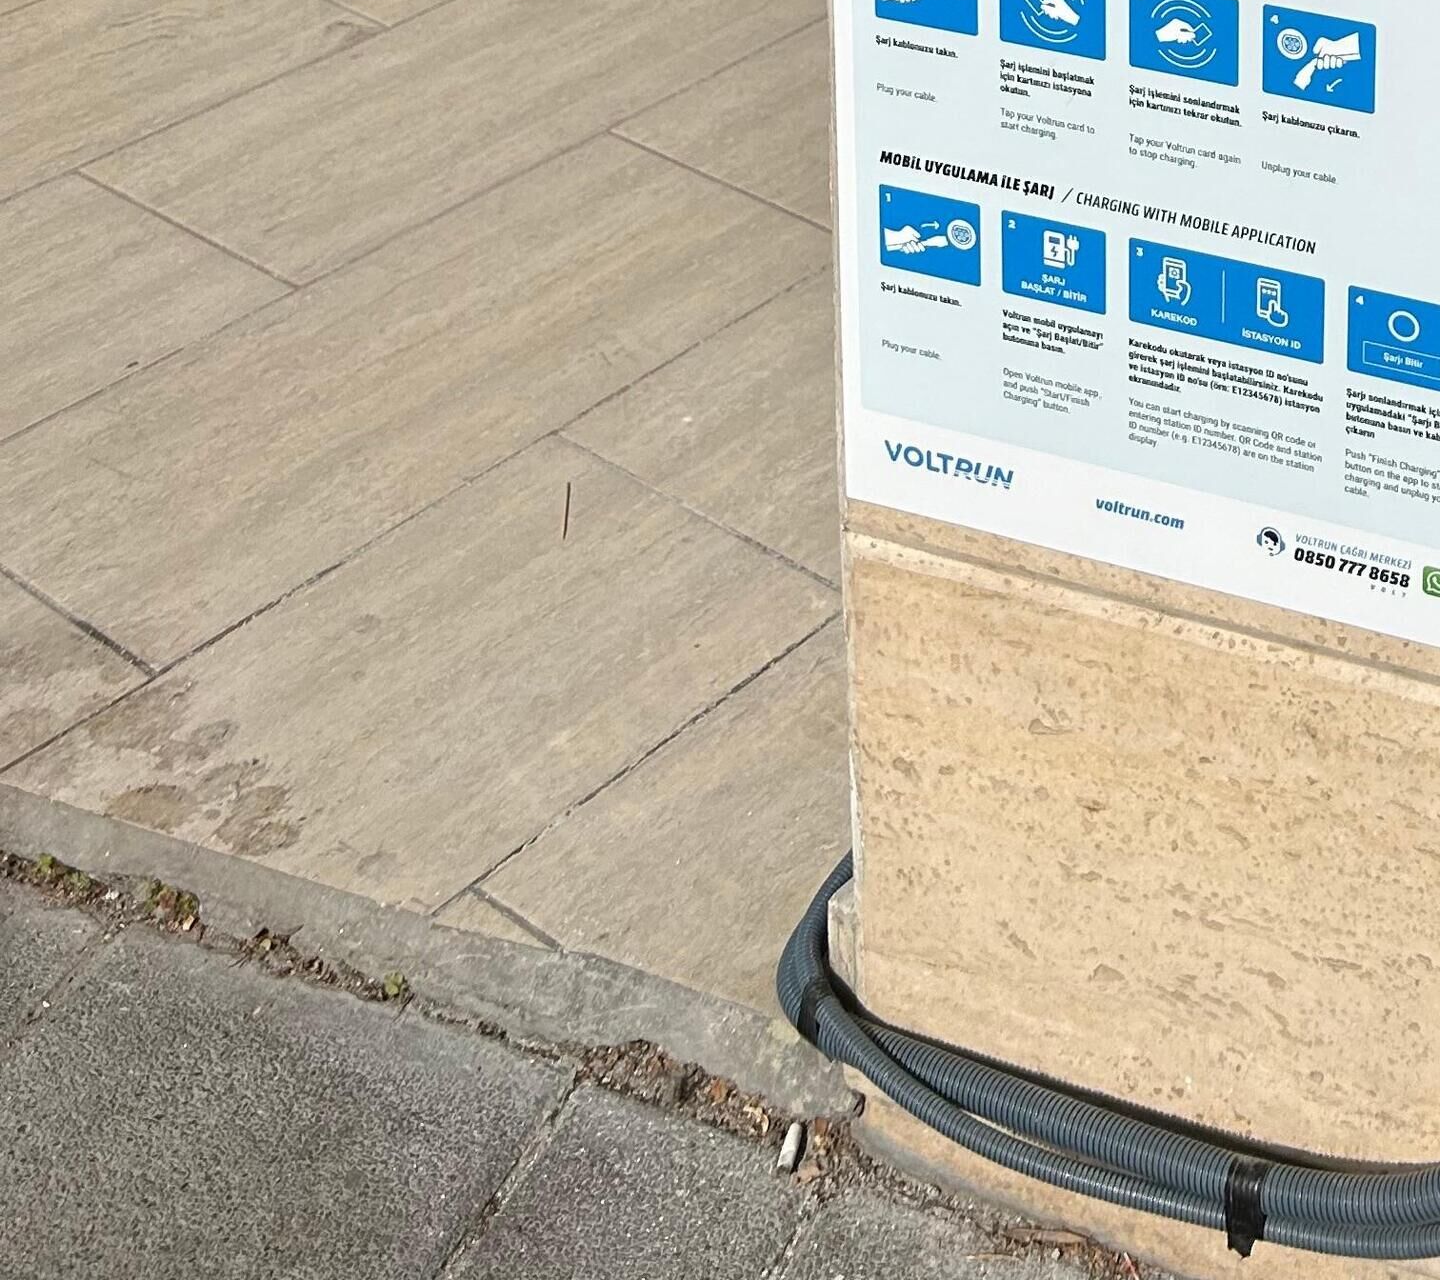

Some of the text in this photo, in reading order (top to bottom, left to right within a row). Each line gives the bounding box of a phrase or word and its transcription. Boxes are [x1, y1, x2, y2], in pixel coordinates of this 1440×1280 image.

[1269, 14, 1279, 24] 4
[879, 150, 921, 170] MOBİL
[924, 159, 998, 187] UYGULAMA
[1022, 180, 1054, 200] ŞARJ
[1076, 191, 1140, 216] CHARGING
[1143, 205, 1177, 224] WITH
[1179, 213, 1229, 236] MOBILE
[1230, 224, 1316, 254] APPLICATION
[885, 192, 891, 202] 1
[1008, 219, 1016, 229] 2
[1136, 246, 1143, 257] 3
[1041, 273, 1066, 286] ŞARJ
[1355, 295, 1364, 305] 4
[1150, 308, 1197, 326] KAREKOD
[1241, 327, 1301, 349] İSTASYON ID
[884, 439, 1014, 490] VOLTRUN
[1095, 498, 1184, 530] voltrun.com
[1295, 533, 1412, 570] VOLTRUN ÇAĞRI MERKEZİ
[1293, 547, 1410, 588] 0850 777 8658
